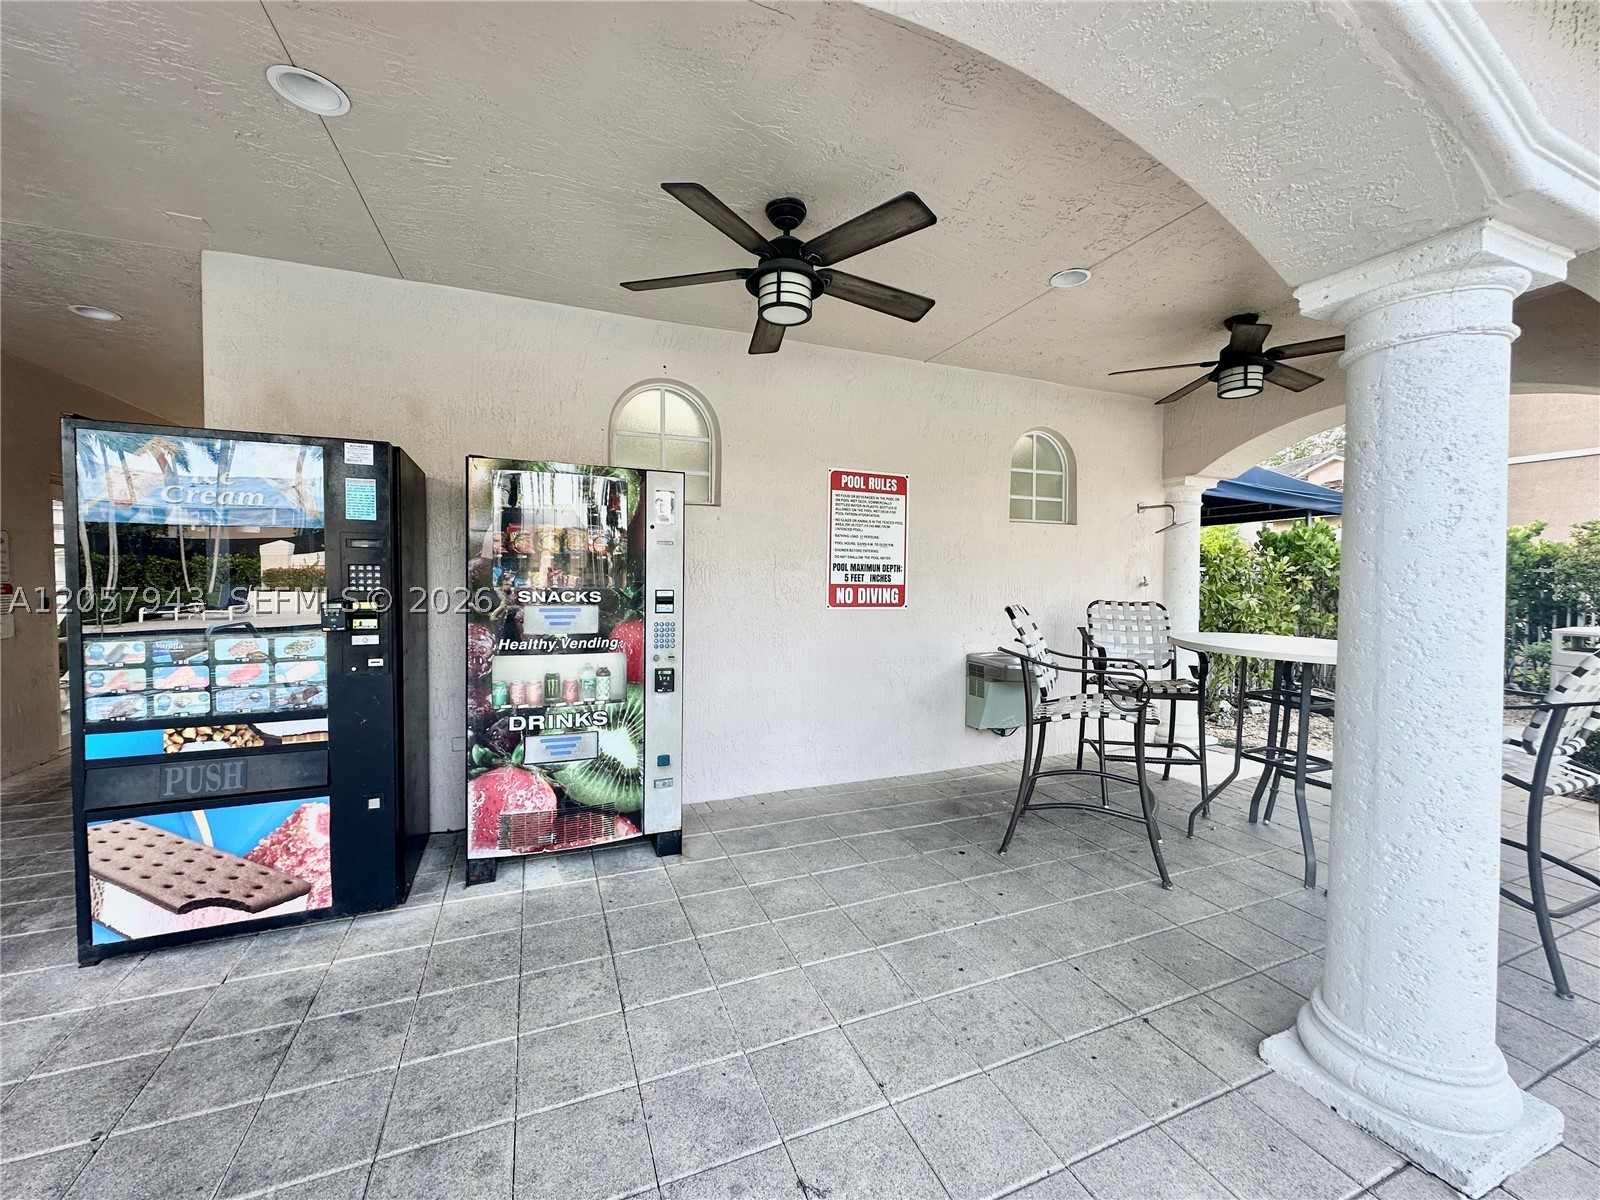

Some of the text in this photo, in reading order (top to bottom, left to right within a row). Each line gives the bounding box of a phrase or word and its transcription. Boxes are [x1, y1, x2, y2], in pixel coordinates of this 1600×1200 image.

[841, 474, 898, 492] POOL RULES
[160, 485, 266, 508] Cream
[832, 562, 849, 572] POOL
[882, 564, 903, 573] DEPTH:
[844, 573, 892, 583] 5 FEET INCHES
[518, 590, 602, 603] SNACKS
[836, 587, 899, 604] NO DIVING
[498, 636, 618, 652] Healthy Vending
[508, 709, 609, 732] DRINKS
[163, 761, 245, 796] PUSH
